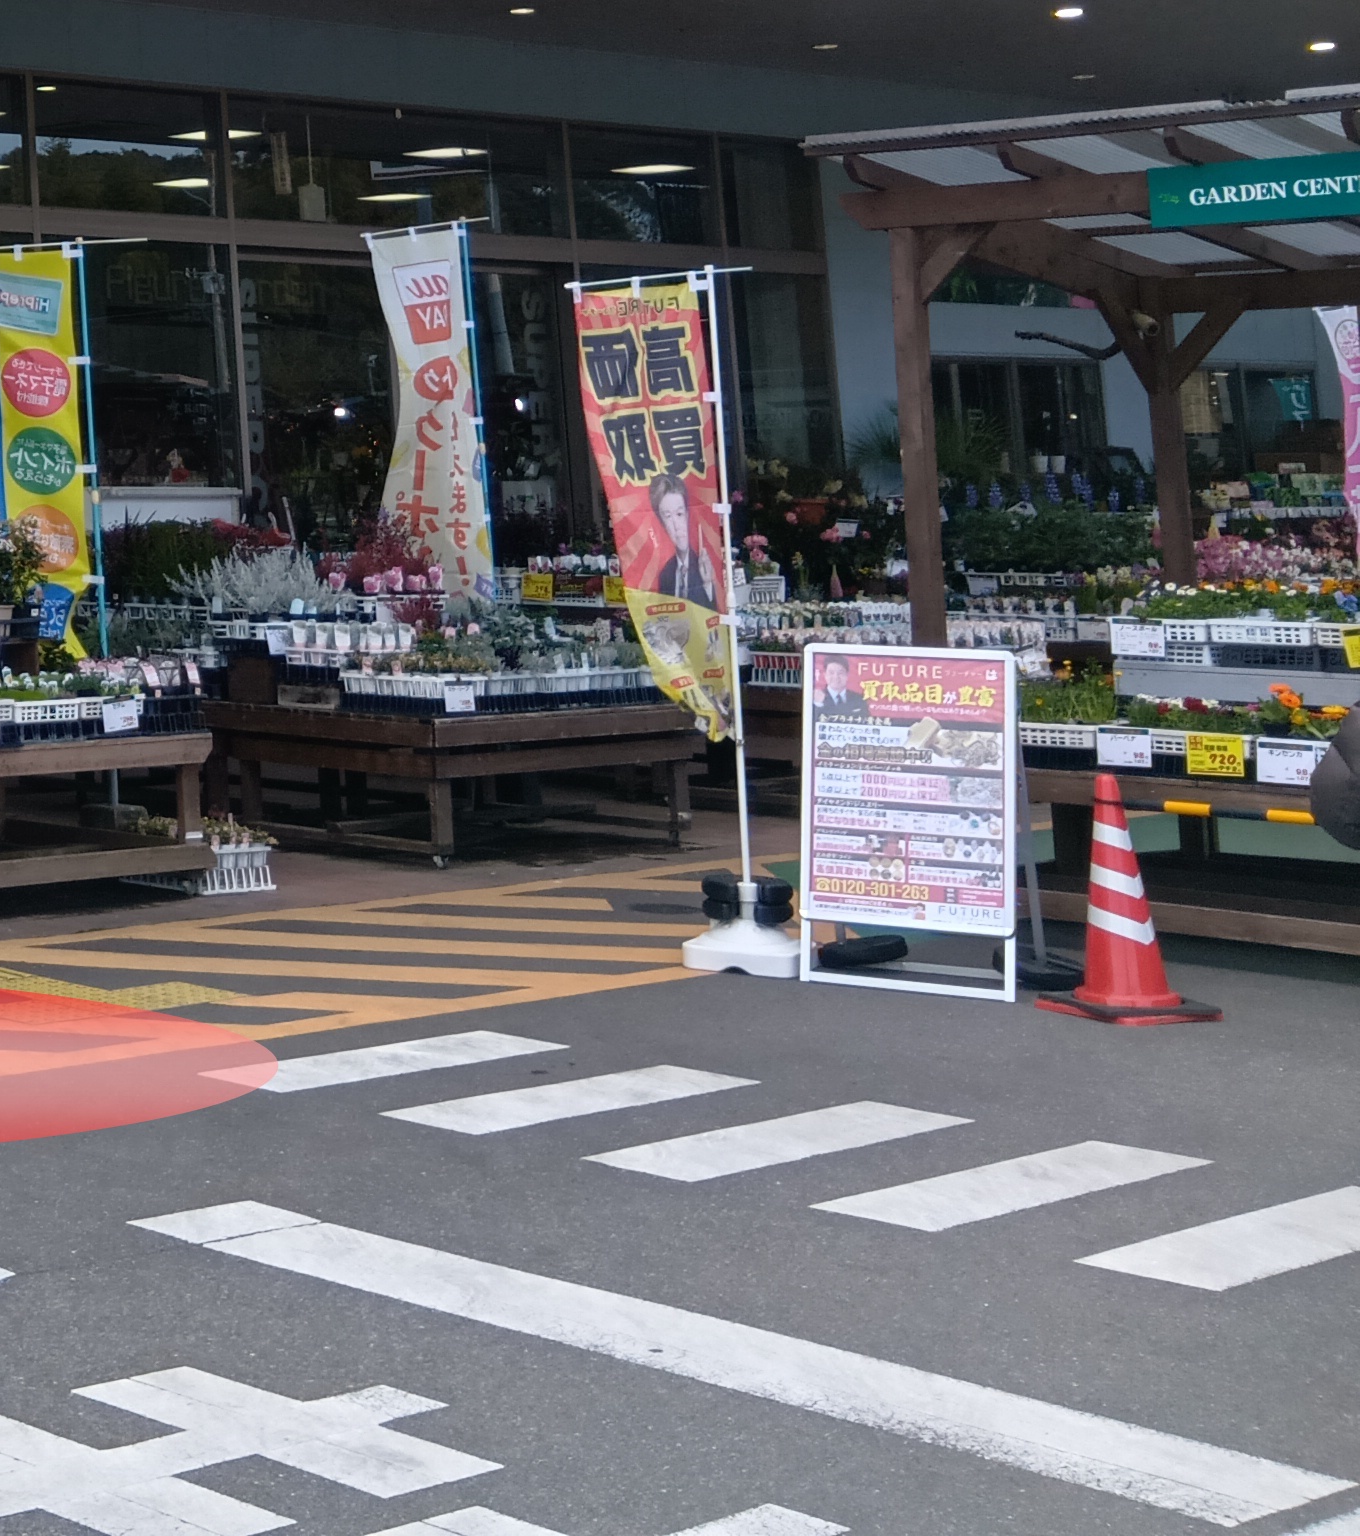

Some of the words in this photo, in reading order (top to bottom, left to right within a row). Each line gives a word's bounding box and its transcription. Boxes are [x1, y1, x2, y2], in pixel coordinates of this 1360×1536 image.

[1189, 181, 1287, 206] GARDEN
[857, 662, 943, 680] FUTURE
[985, 668, 998, 681] は
[859, 680, 997, 708] 買取品目が豊富
[1268, 748, 1303, 758] キンセンカ
[831, 880, 929, 901] 0120-301-263
[937, 905, 1002, 920] FUTURE
